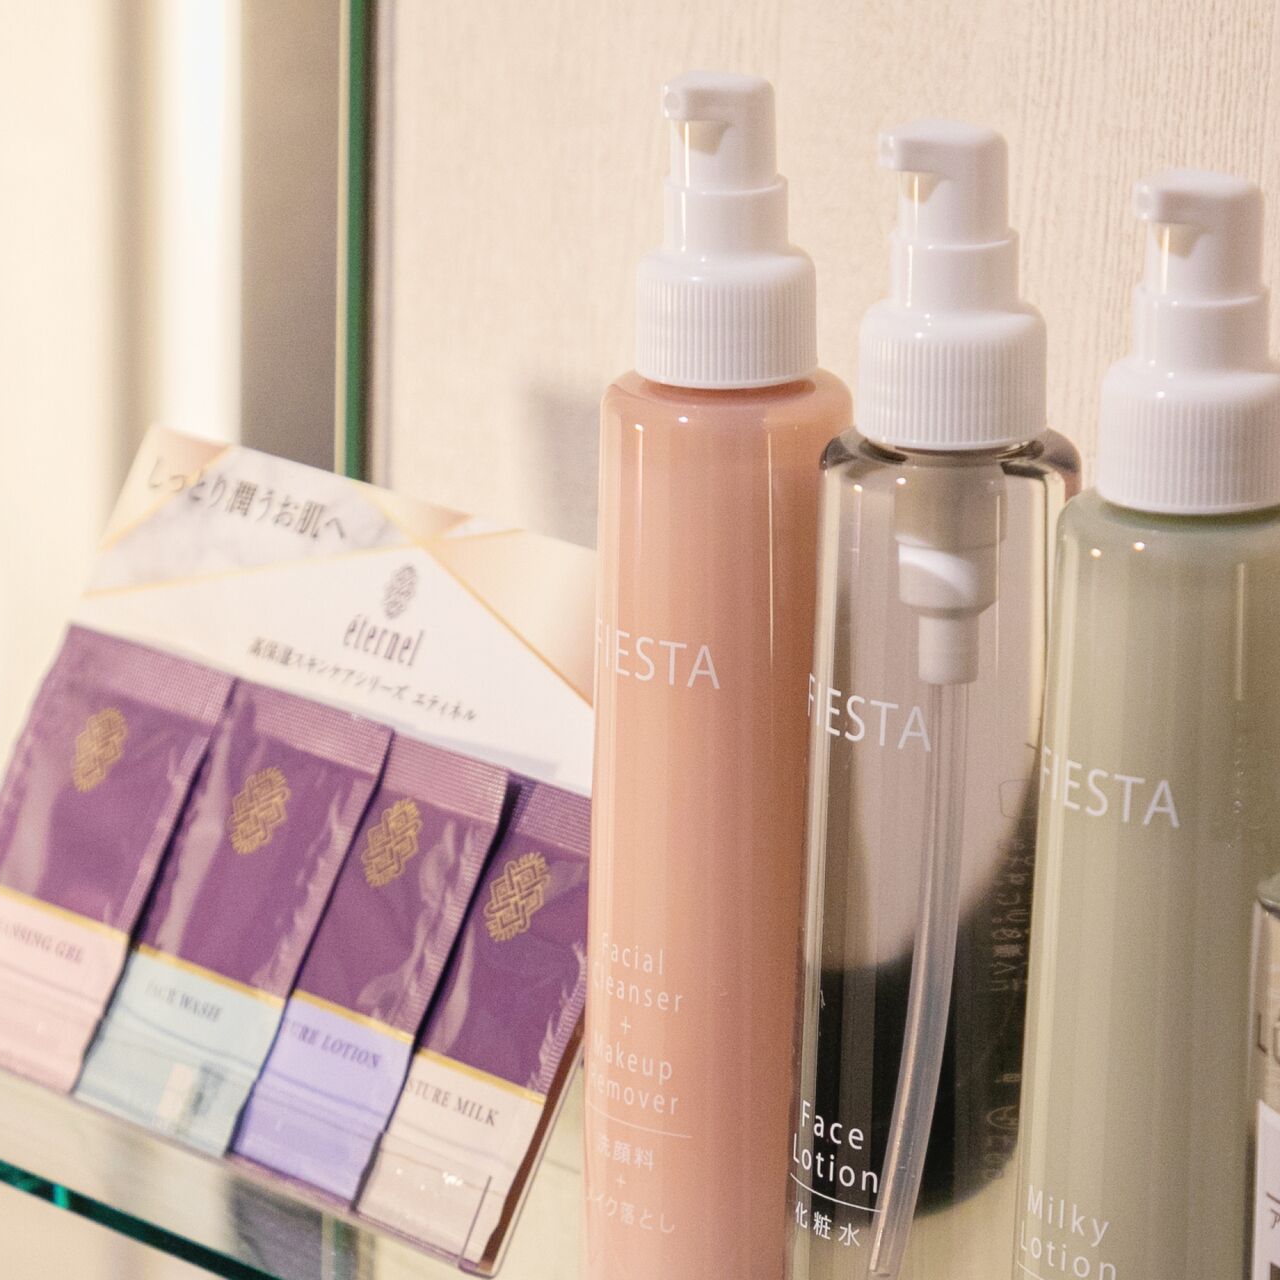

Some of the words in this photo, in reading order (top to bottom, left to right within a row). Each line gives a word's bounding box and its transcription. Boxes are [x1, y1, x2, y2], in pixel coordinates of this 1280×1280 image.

[148, 457, 346, 540] しっとり潤うお肌へ
[343, 613, 424, 668] éternel
[595, 617, 721, 691] FIESTA
[806, 672, 932, 752] FIESTA
[1040, 745, 1180, 829] FIESTA
[600, 932, 665, 976] Facial
[592, 962, 683, 1013] Cleanser
[593, 1032, 673, 1086] Makeup
[455, 1094, 500, 1128] MILK
[800, 1099, 865, 1150] Face
[792, 1132, 880, 1194] Lotion
[794, 1200, 861, 1248] 化粧水
[1026, 1183, 1110, 1248] Milky
